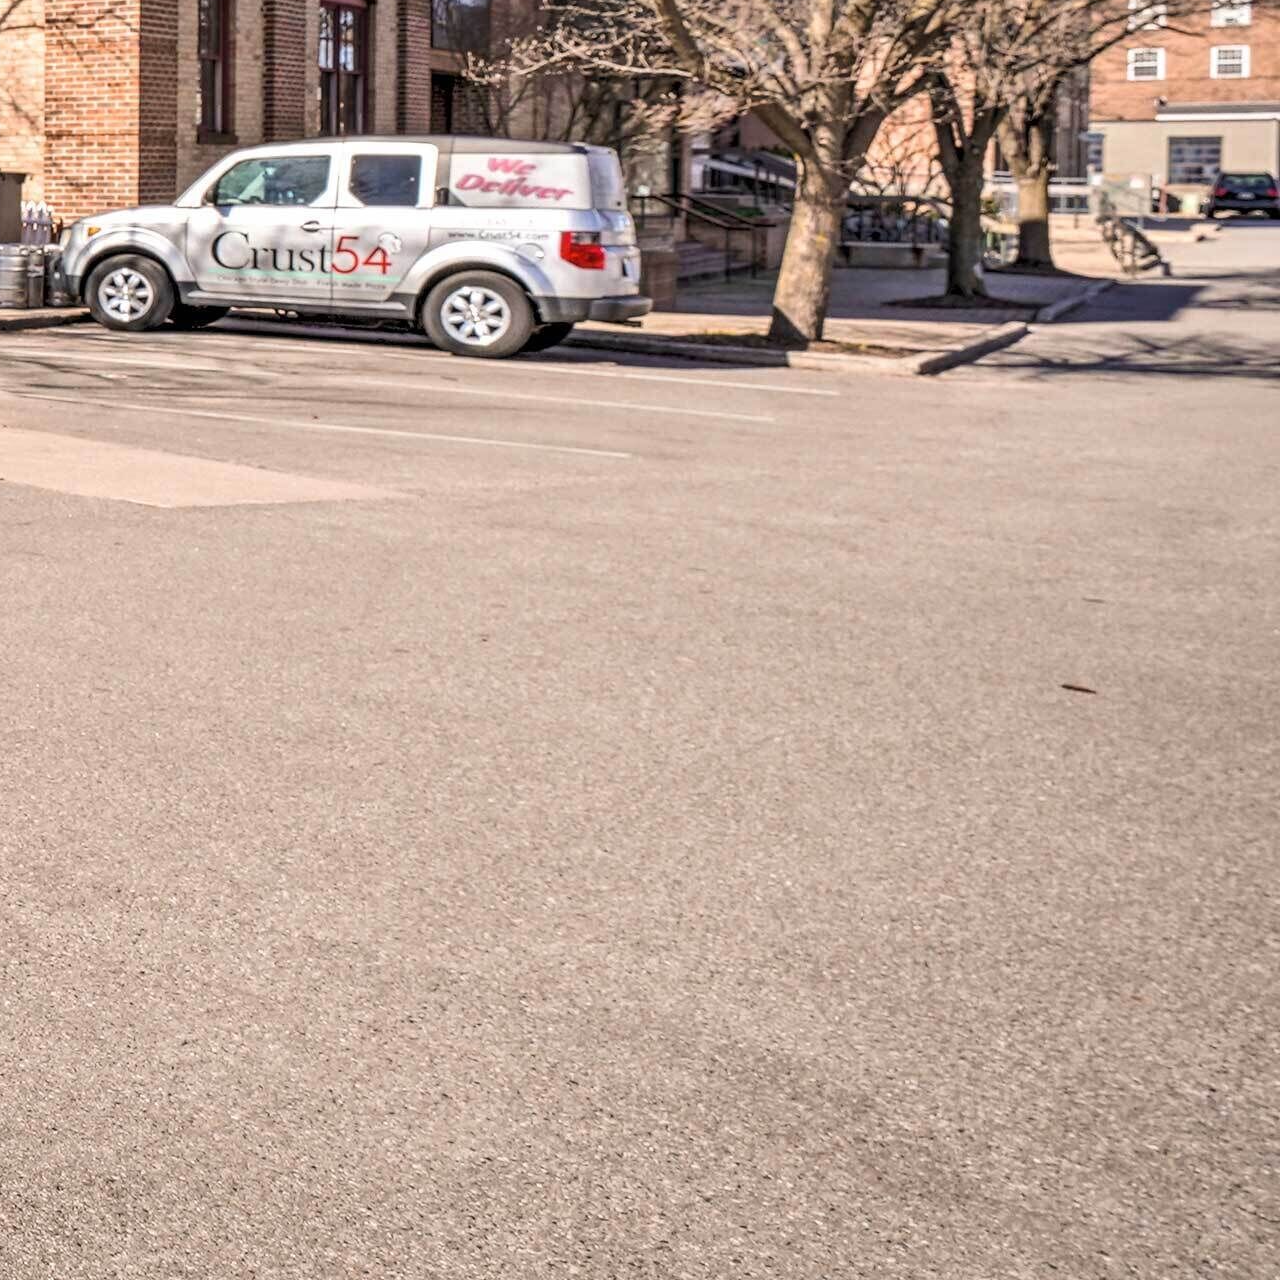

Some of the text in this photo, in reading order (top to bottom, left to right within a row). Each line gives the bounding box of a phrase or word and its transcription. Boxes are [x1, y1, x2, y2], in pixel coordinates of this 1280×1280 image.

[487, 157, 537, 176] We
[455, 174, 574, 200] Deliver
[211, 231, 392, 275] Crust54
